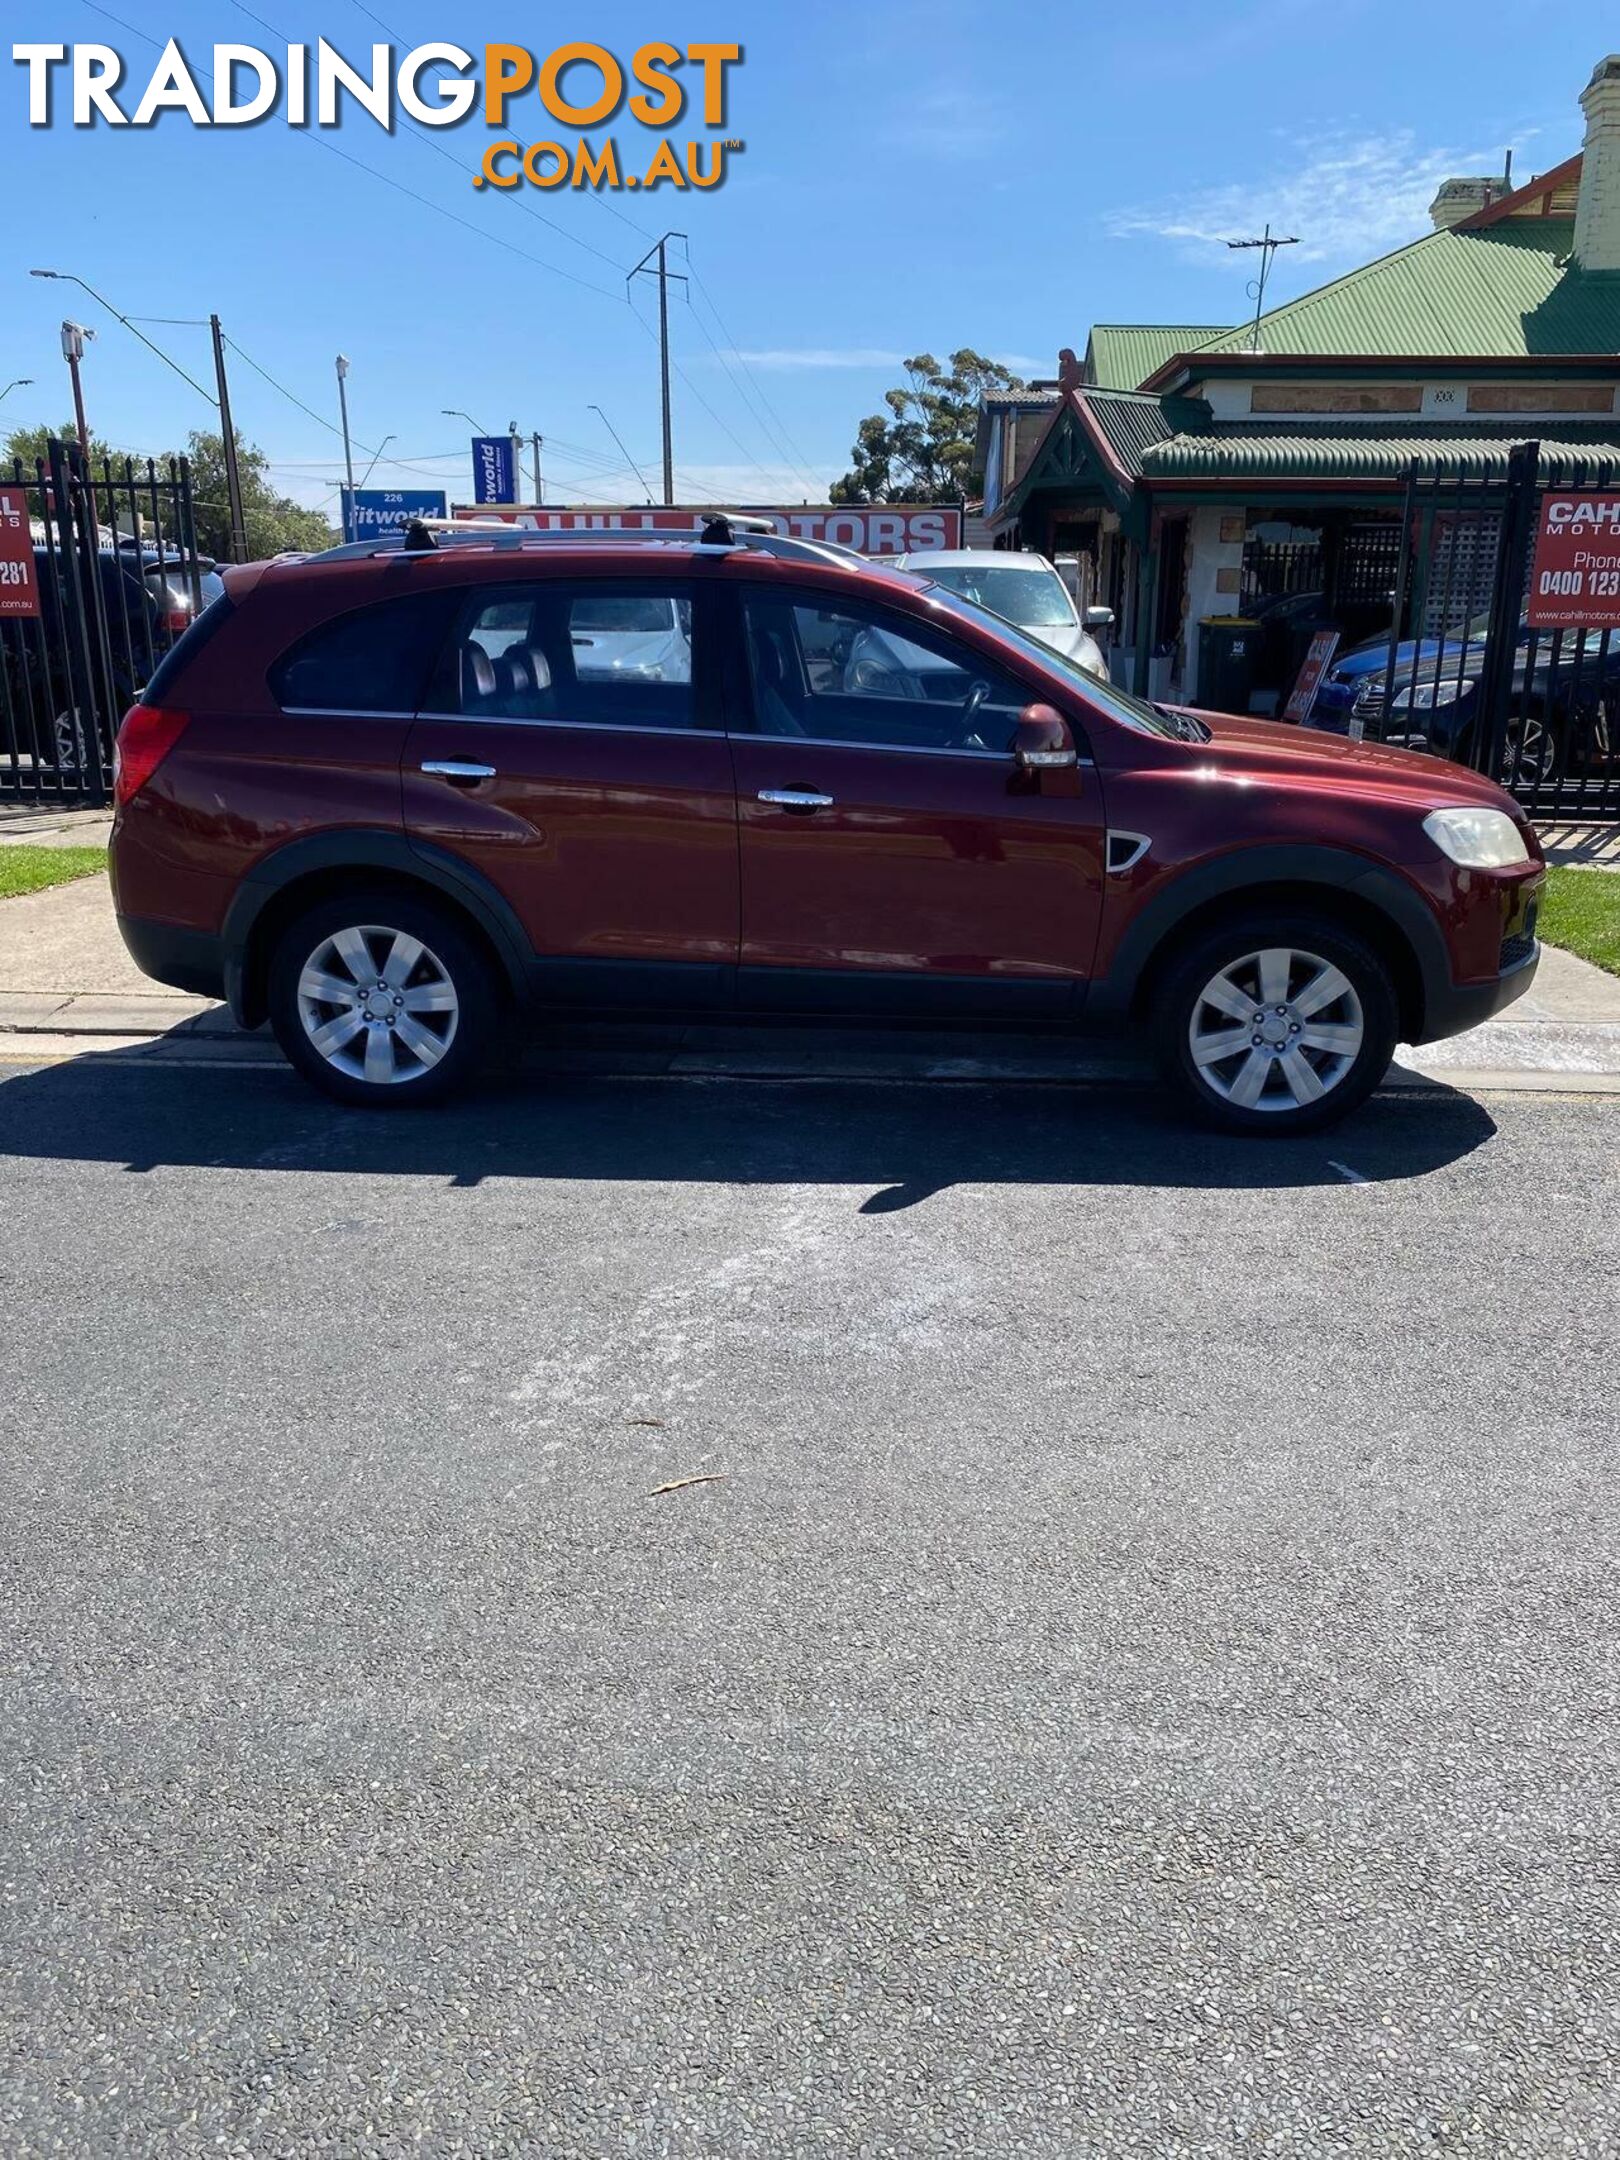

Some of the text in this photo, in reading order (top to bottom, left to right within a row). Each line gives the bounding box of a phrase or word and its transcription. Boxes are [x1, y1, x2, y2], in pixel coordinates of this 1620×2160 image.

[384, 493, 403, 503] 226
[0, 561, 29, 585] 281
[1540, 571, 1619, 596] 0400 123
